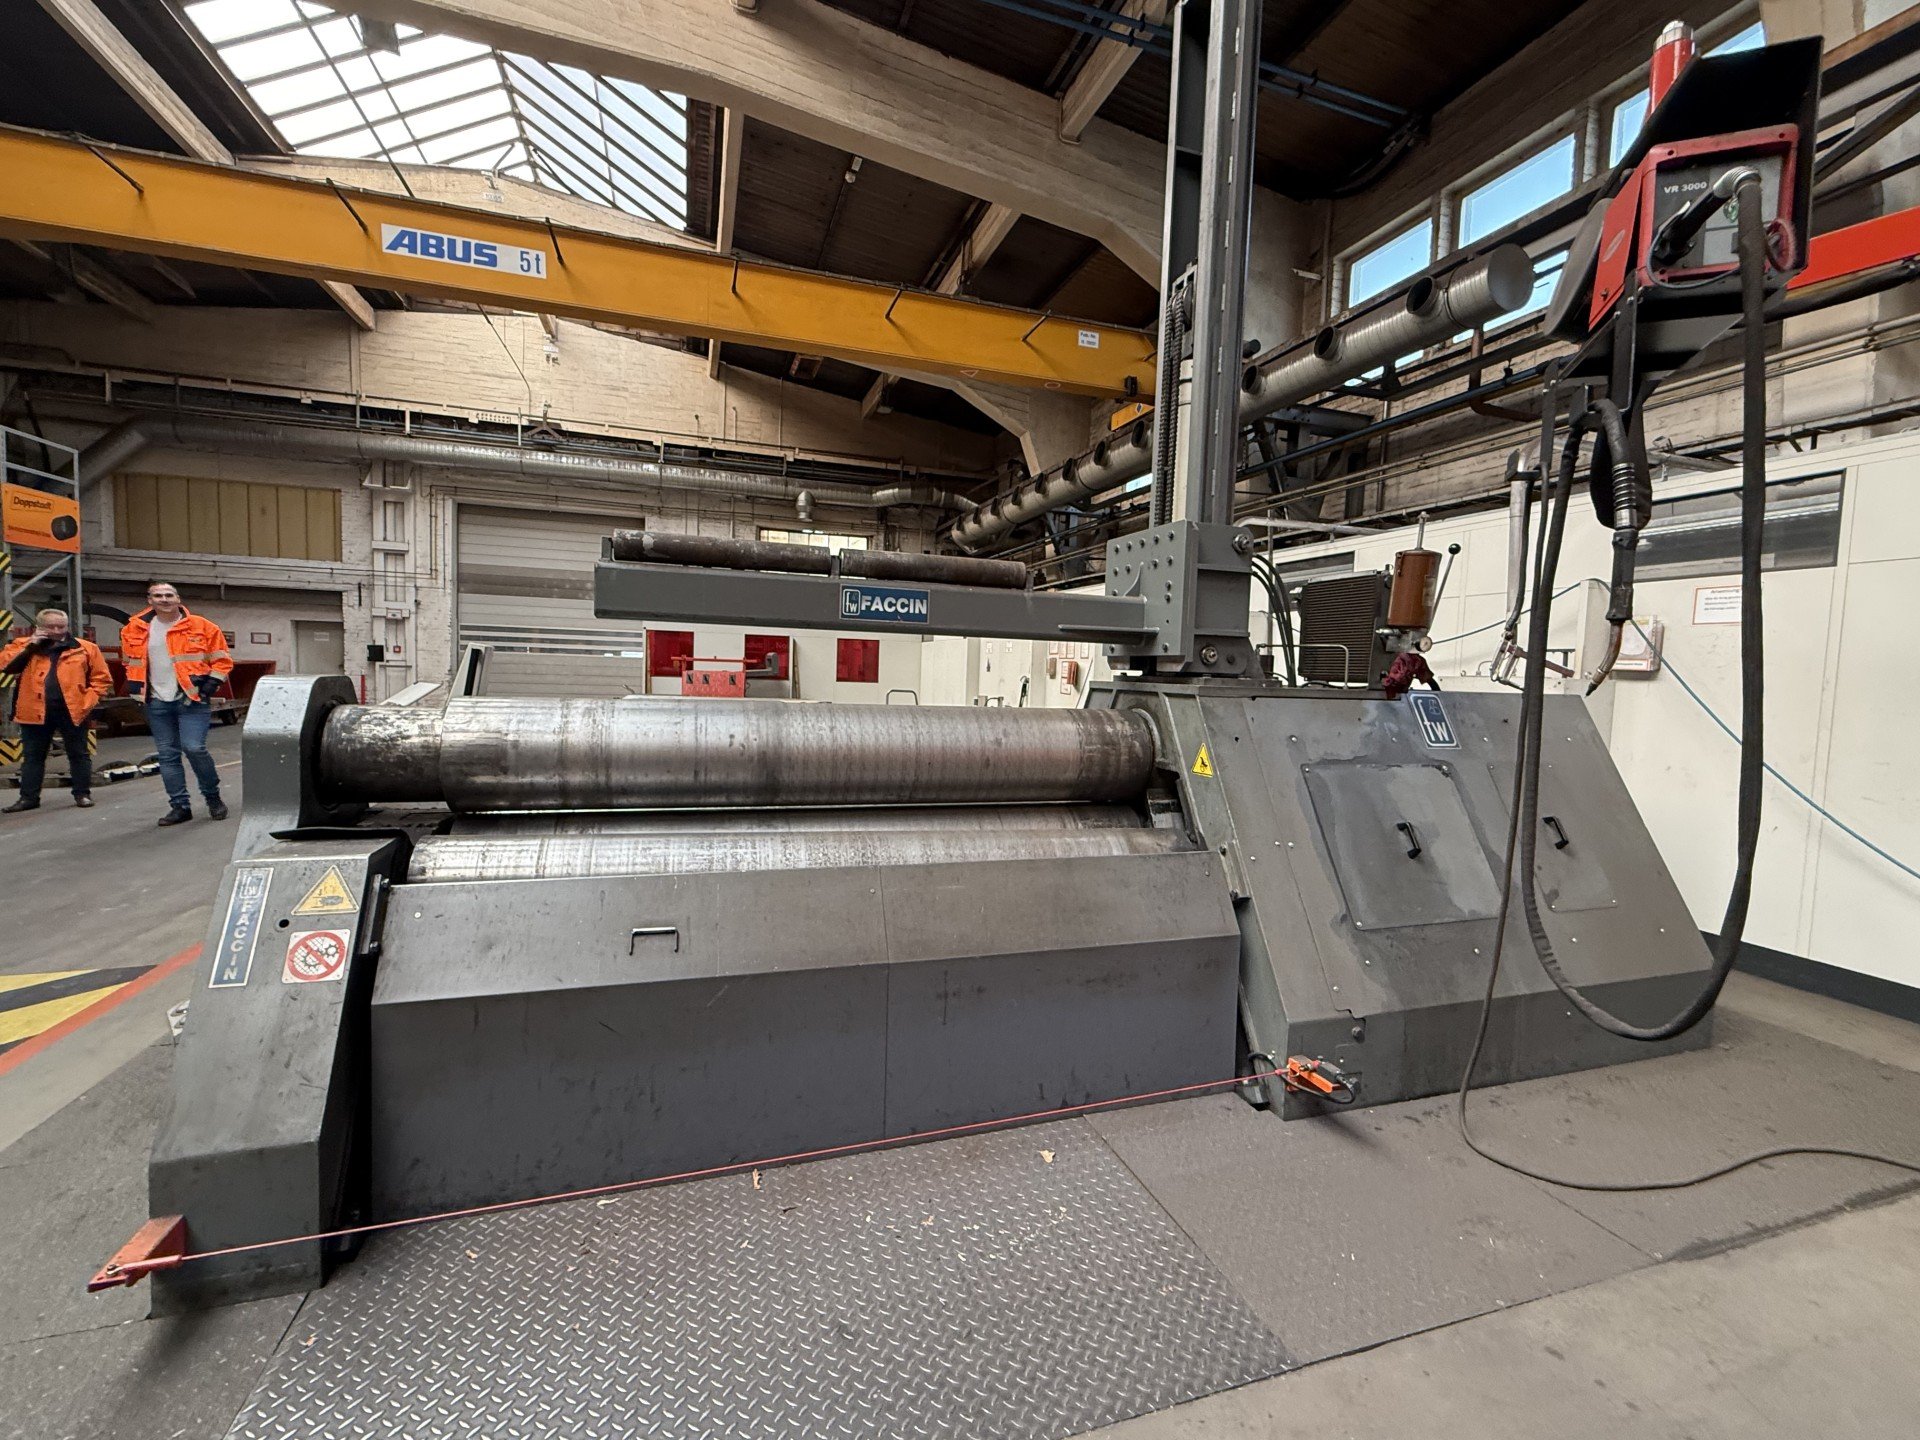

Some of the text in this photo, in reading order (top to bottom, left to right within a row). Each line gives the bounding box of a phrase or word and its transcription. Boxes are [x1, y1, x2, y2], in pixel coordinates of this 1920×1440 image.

[1664, 181, 1708, 194] VR 3000
[385, 229, 498, 268] ABUS
[861, 595, 928, 615] FACCIN
[222, 900, 253, 981] FACCIN
